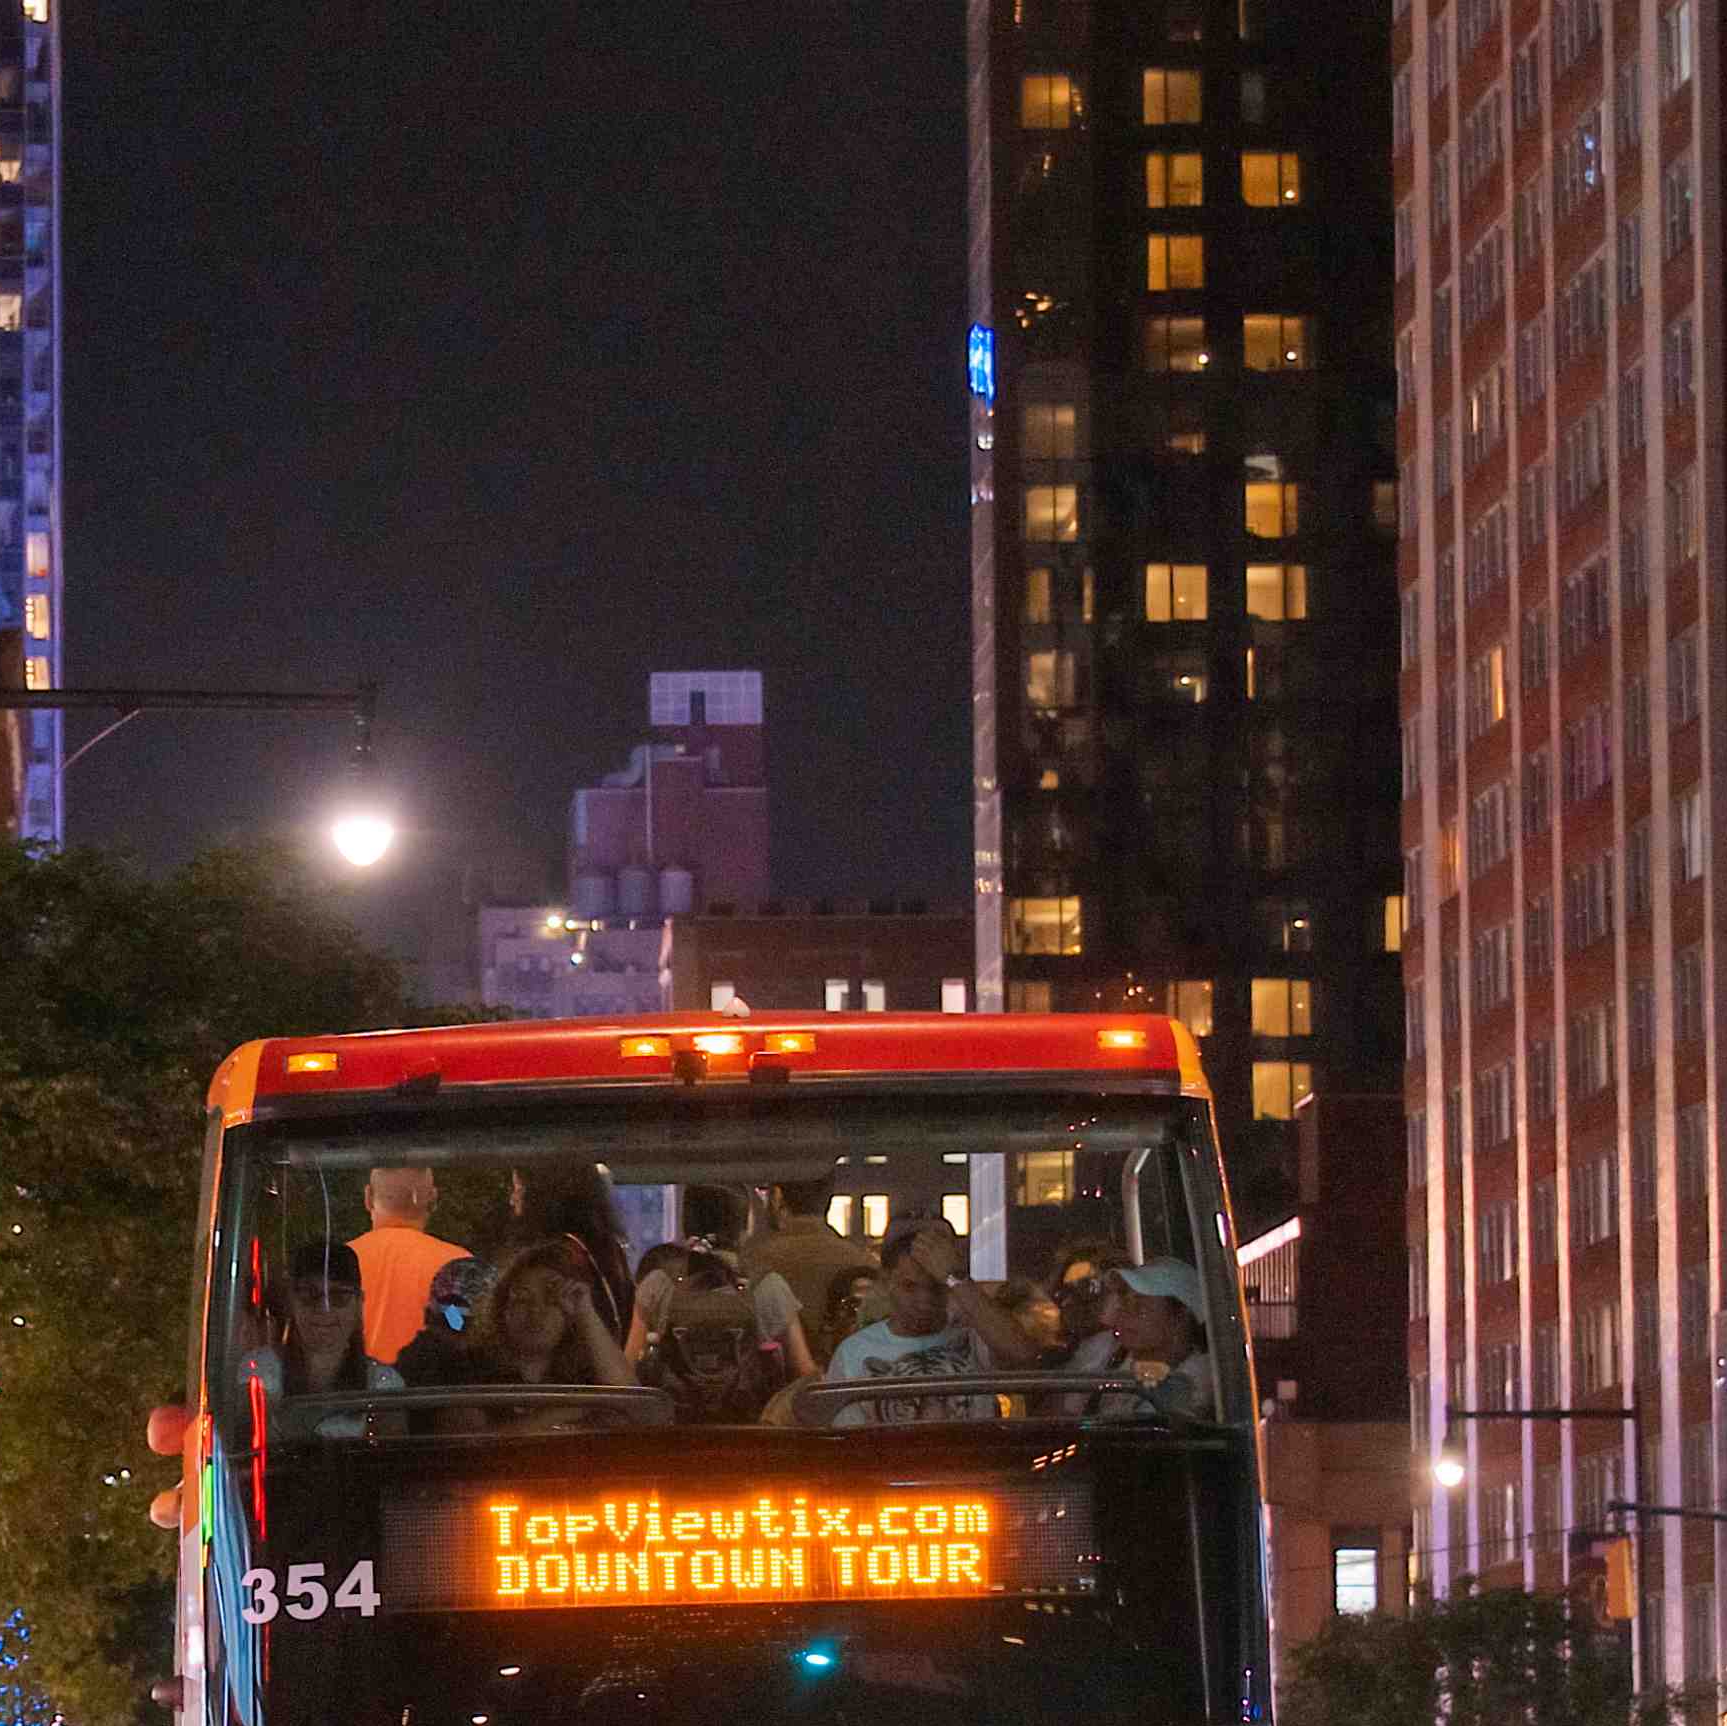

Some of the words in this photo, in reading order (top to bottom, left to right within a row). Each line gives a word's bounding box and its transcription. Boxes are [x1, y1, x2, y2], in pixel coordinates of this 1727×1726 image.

[239, 1560, 382, 1625] 354
[495, 1545, 806, 1598] DOWNTOWN
[832, 1542, 984, 1589] TOUR
